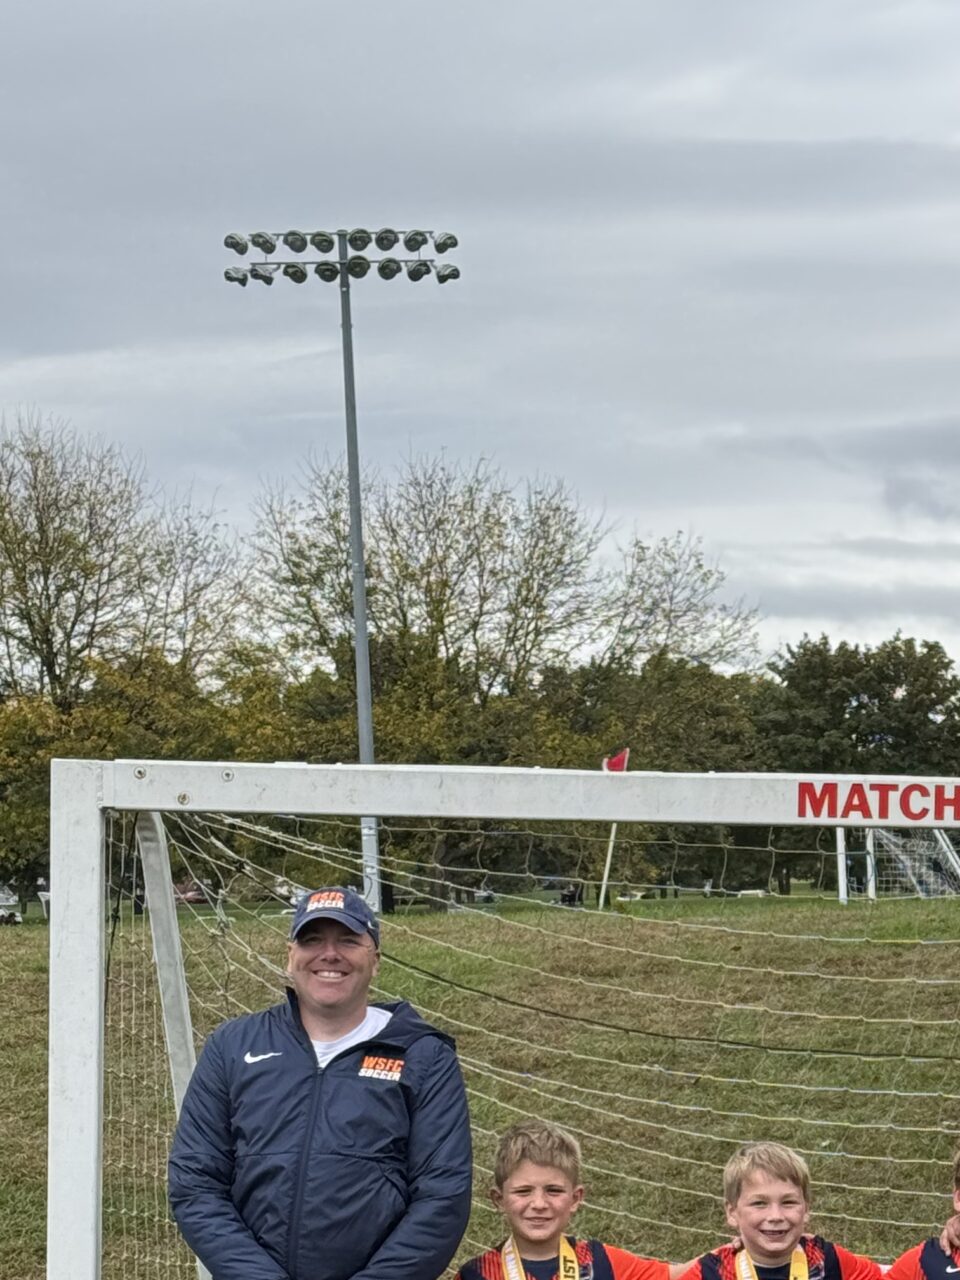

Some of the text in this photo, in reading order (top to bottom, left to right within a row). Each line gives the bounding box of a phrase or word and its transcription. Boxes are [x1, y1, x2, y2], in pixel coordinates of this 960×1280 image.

[309, 891, 345, 903] WSFC
[362, 1055, 405, 1073] WSFC
[358, 1067, 401, 1081] SOCCER
